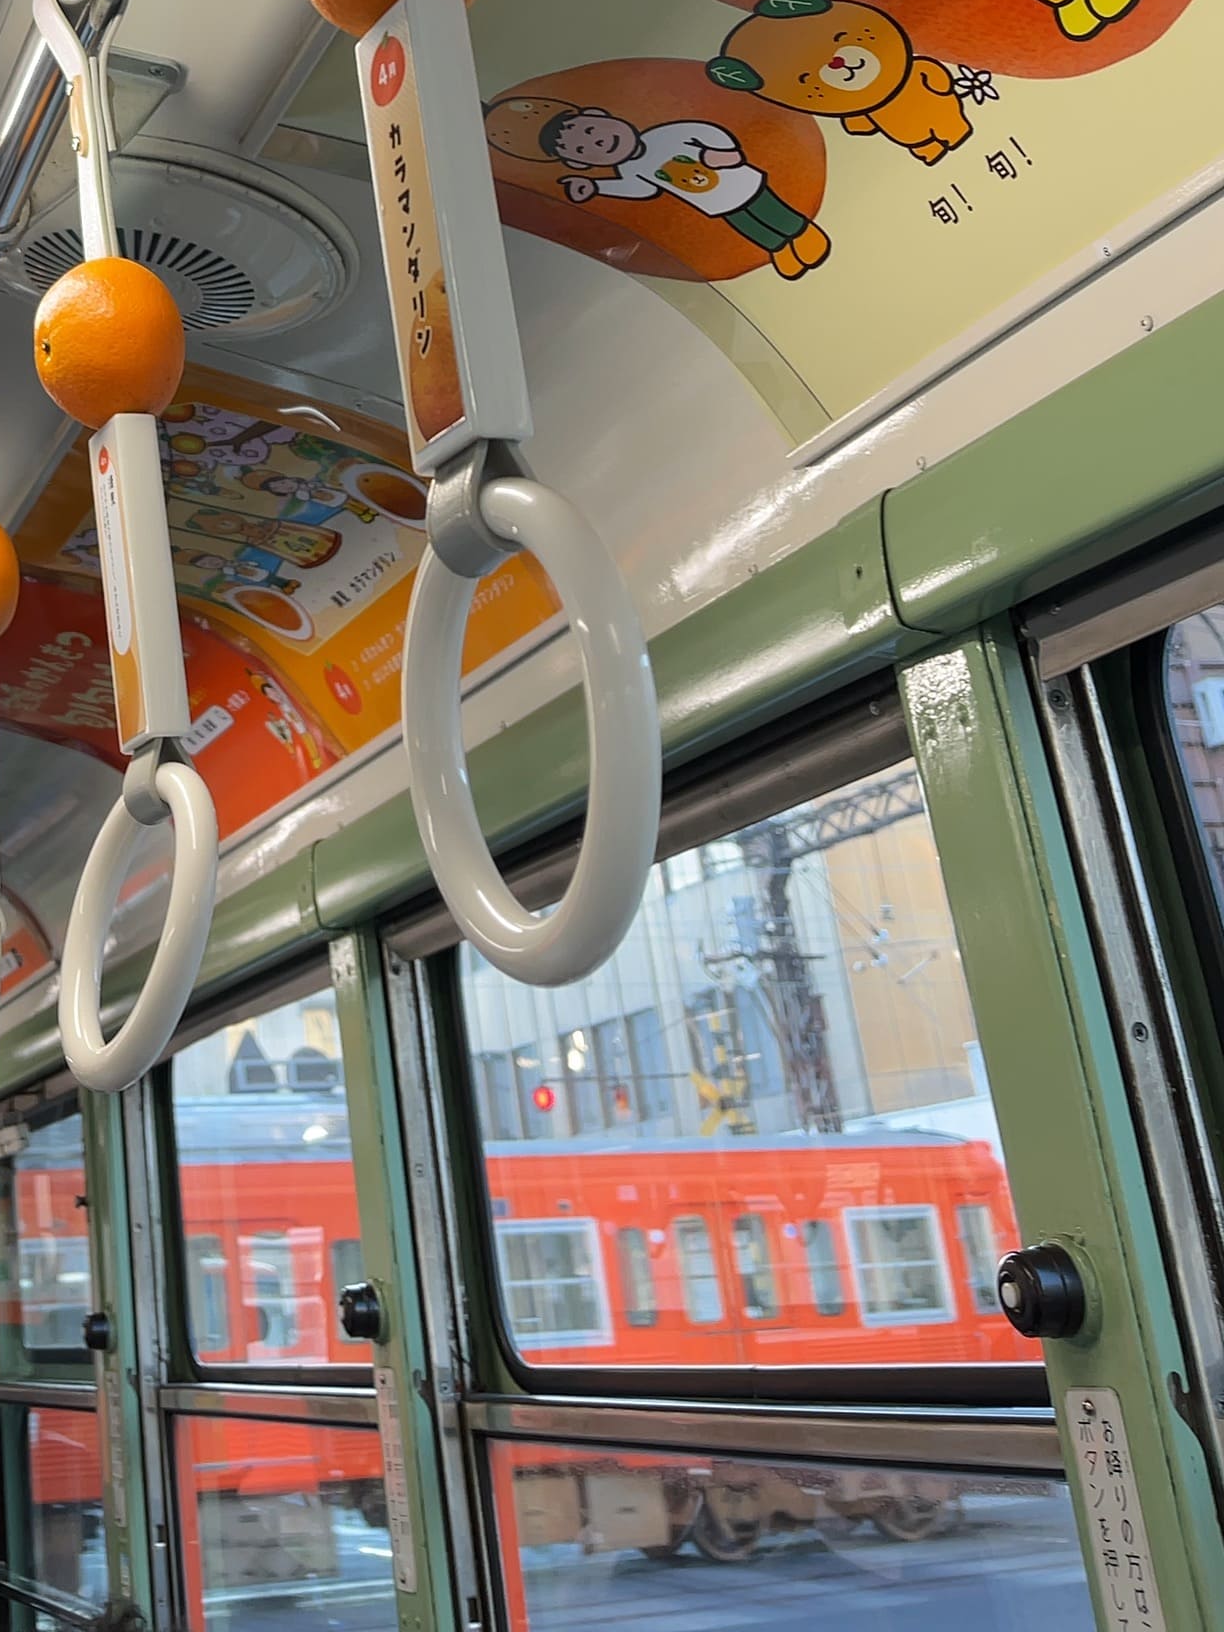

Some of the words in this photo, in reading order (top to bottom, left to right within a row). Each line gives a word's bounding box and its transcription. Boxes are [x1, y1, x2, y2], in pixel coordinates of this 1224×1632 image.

[378, 58, 398, 86] 4月
[928, 183, 974, 225] 旬!
[985, 136, 1033, 180] 旬!
[389, 122, 433, 356] カラマンダリン
